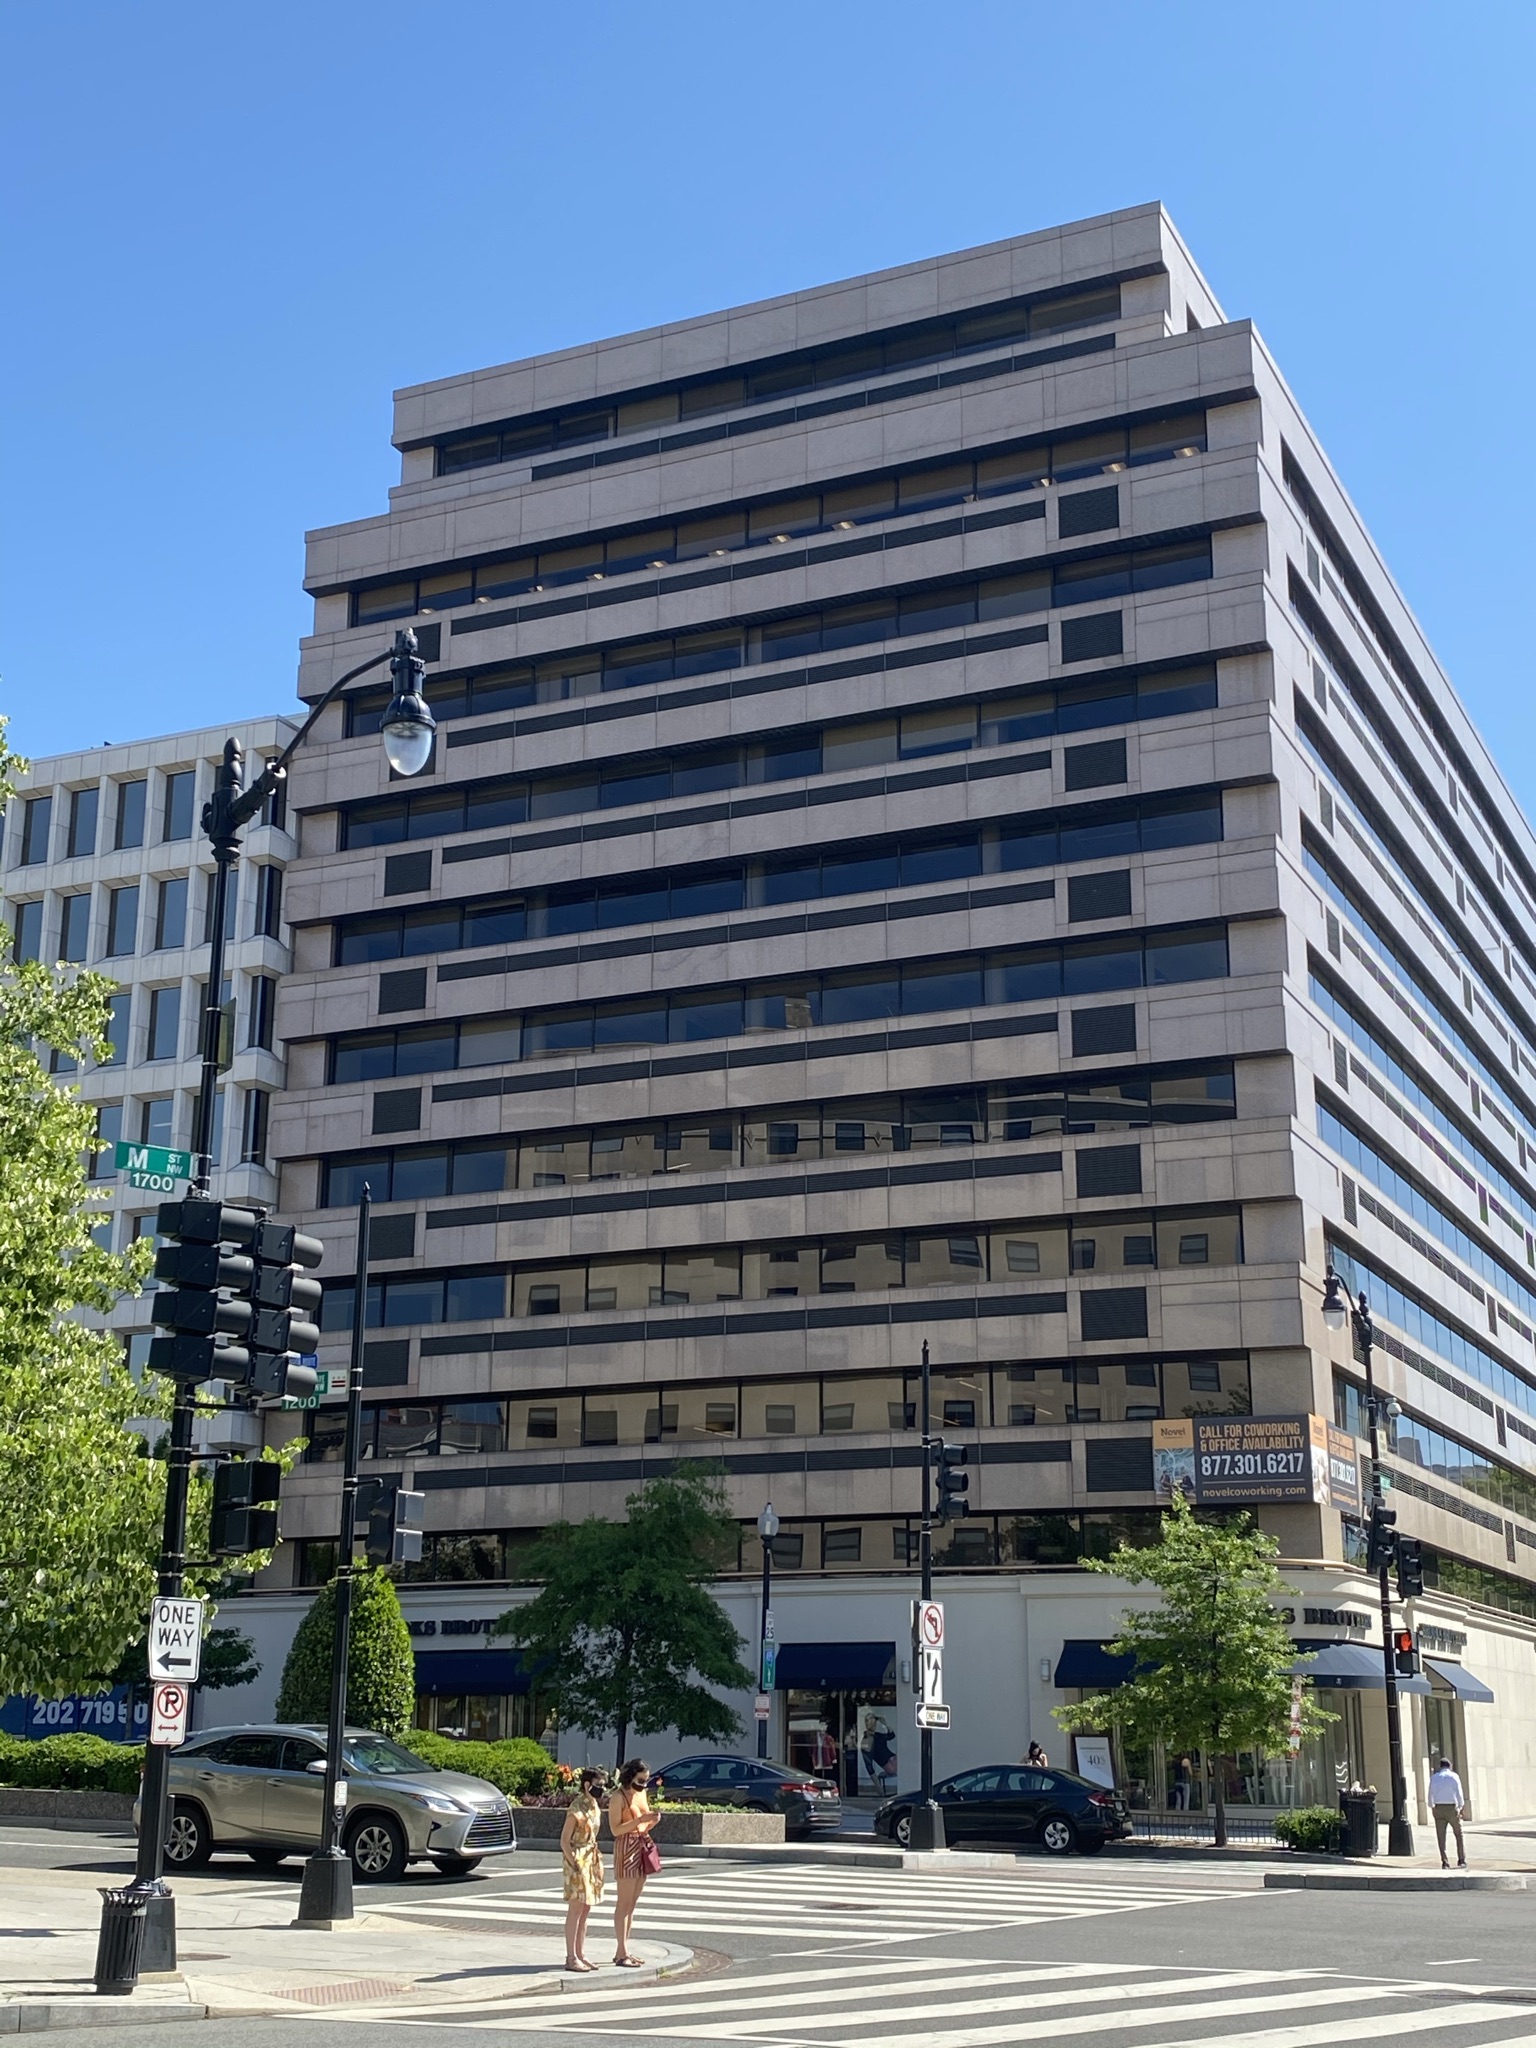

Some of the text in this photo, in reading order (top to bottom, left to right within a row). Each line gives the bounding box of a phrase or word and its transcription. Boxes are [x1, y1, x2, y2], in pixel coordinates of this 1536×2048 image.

[127, 1147, 182, 1170] M ST
[166, 1164, 183, 1175] NW
[132, 1172, 174, 1192] 1700
[1160, 1427, 1186, 1436] Novel
[1199, 1424, 1222, 1439] CALL
[1224, 1424, 1243, 1438] FOR
[1244, 1422, 1300, 1437] COWORKING
[1210, 1438, 1240, 1451] OFFICE
[1243, 1436, 1304, 1450] AVAILABILITY
[1201, 1453, 1304, 1476] 877.301.6217
[1202, 1485, 1306, 1498] novelcoworking.com
[159, 1605, 195, 1625] ONE
[158, 1627, 195, 1647] WAY
[32, 1701, 74, 1725] 202
[80, 1701, 115, 1724] 719
[926, 1711, 935, 1720] ONE
